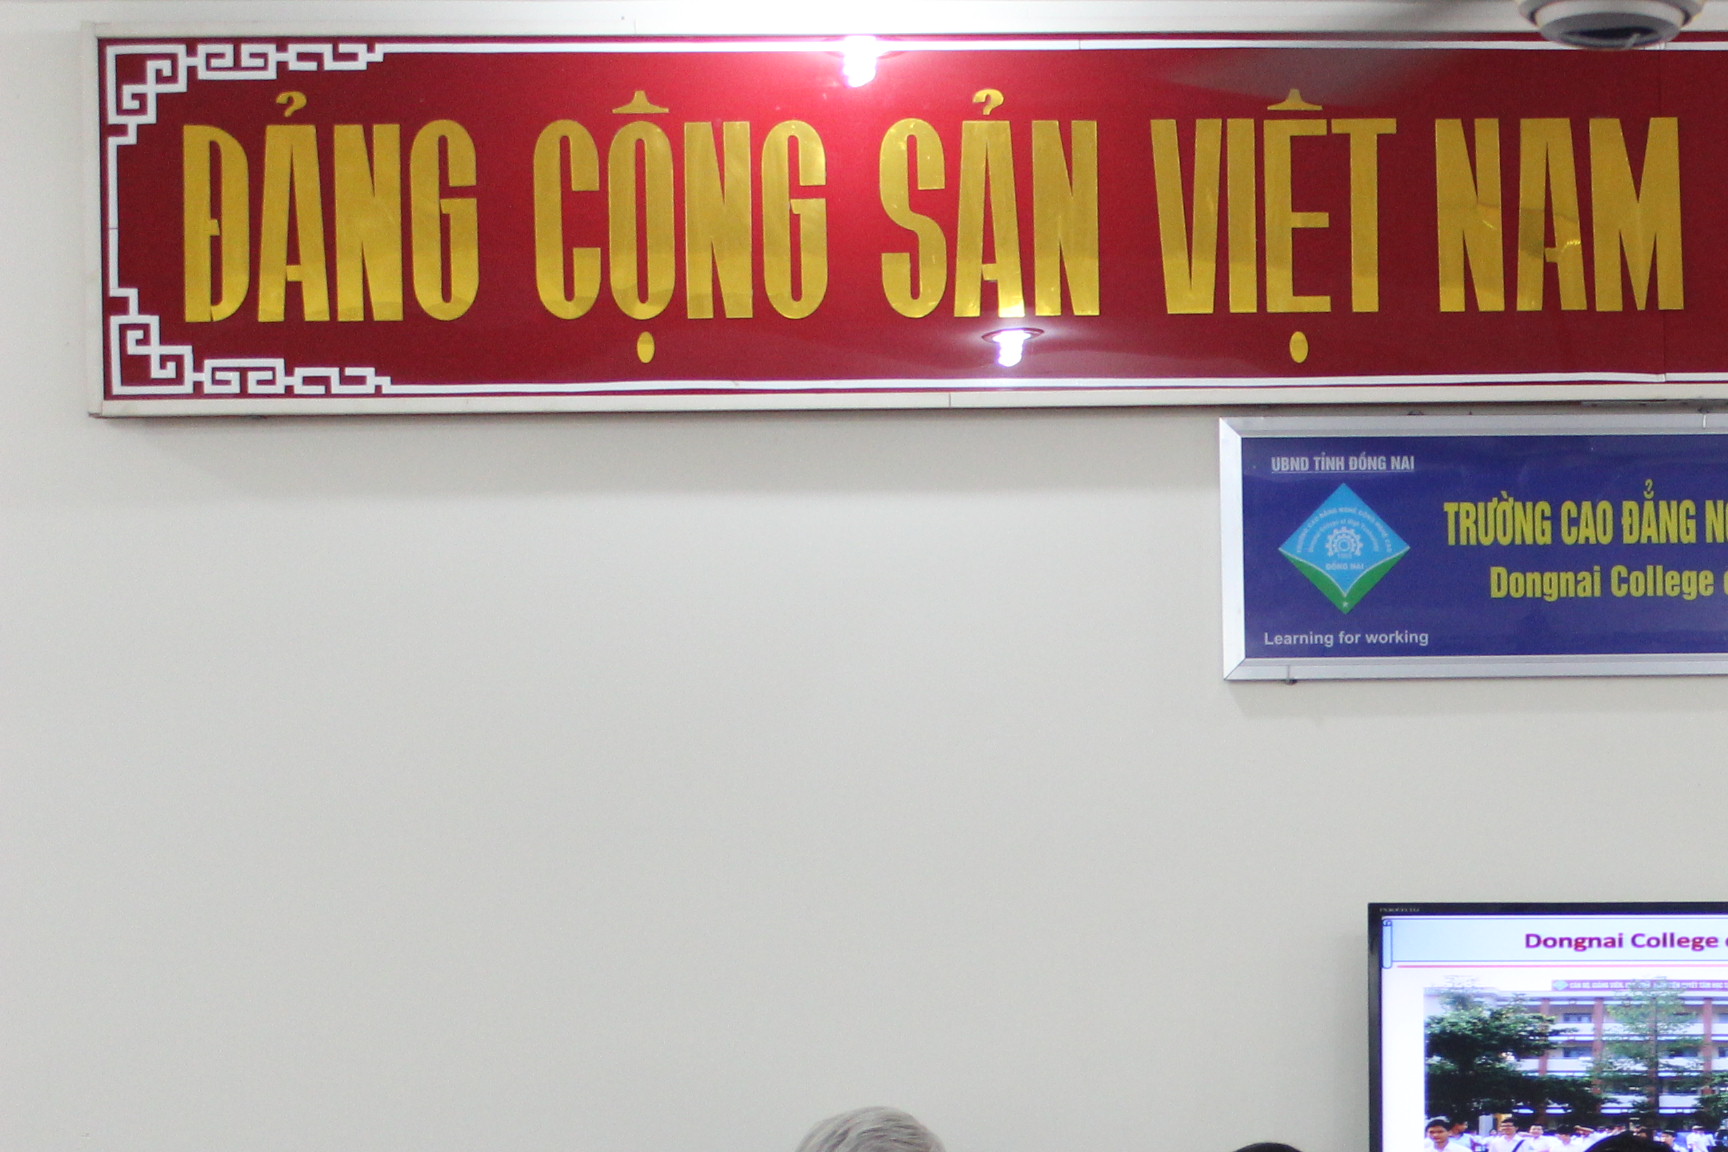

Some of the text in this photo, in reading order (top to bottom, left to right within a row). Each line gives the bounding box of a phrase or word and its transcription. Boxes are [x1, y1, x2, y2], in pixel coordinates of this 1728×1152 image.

[184, 90, 477, 323] ĐẢNG
[533, 89, 828, 365] CỘNG
[880, 88, 1099, 320] SẢN
[1150, 87, 1398, 365] VIỆT
[1435, 117, 1685, 312] NAM
[1271, 456, 1309, 472] UBND
[1312, 451, 1345, 471] TỈNH
[1390, 455, 1415, 470] NAI
[1444, 490, 1552, 545] TRƯỜNG
[1561, 499, 1614, 545] CAO
[1621, 478, 1697, 544] ĐẲNG
[1490, 565, 1601, 602] Dongnai
[1610, 564, 1715, 600] College
[1264, 630, 1429, 648] Learning for working
[1524, 932, 1624, 952] Dongnai
[1630, 932, 1719, 952] College
